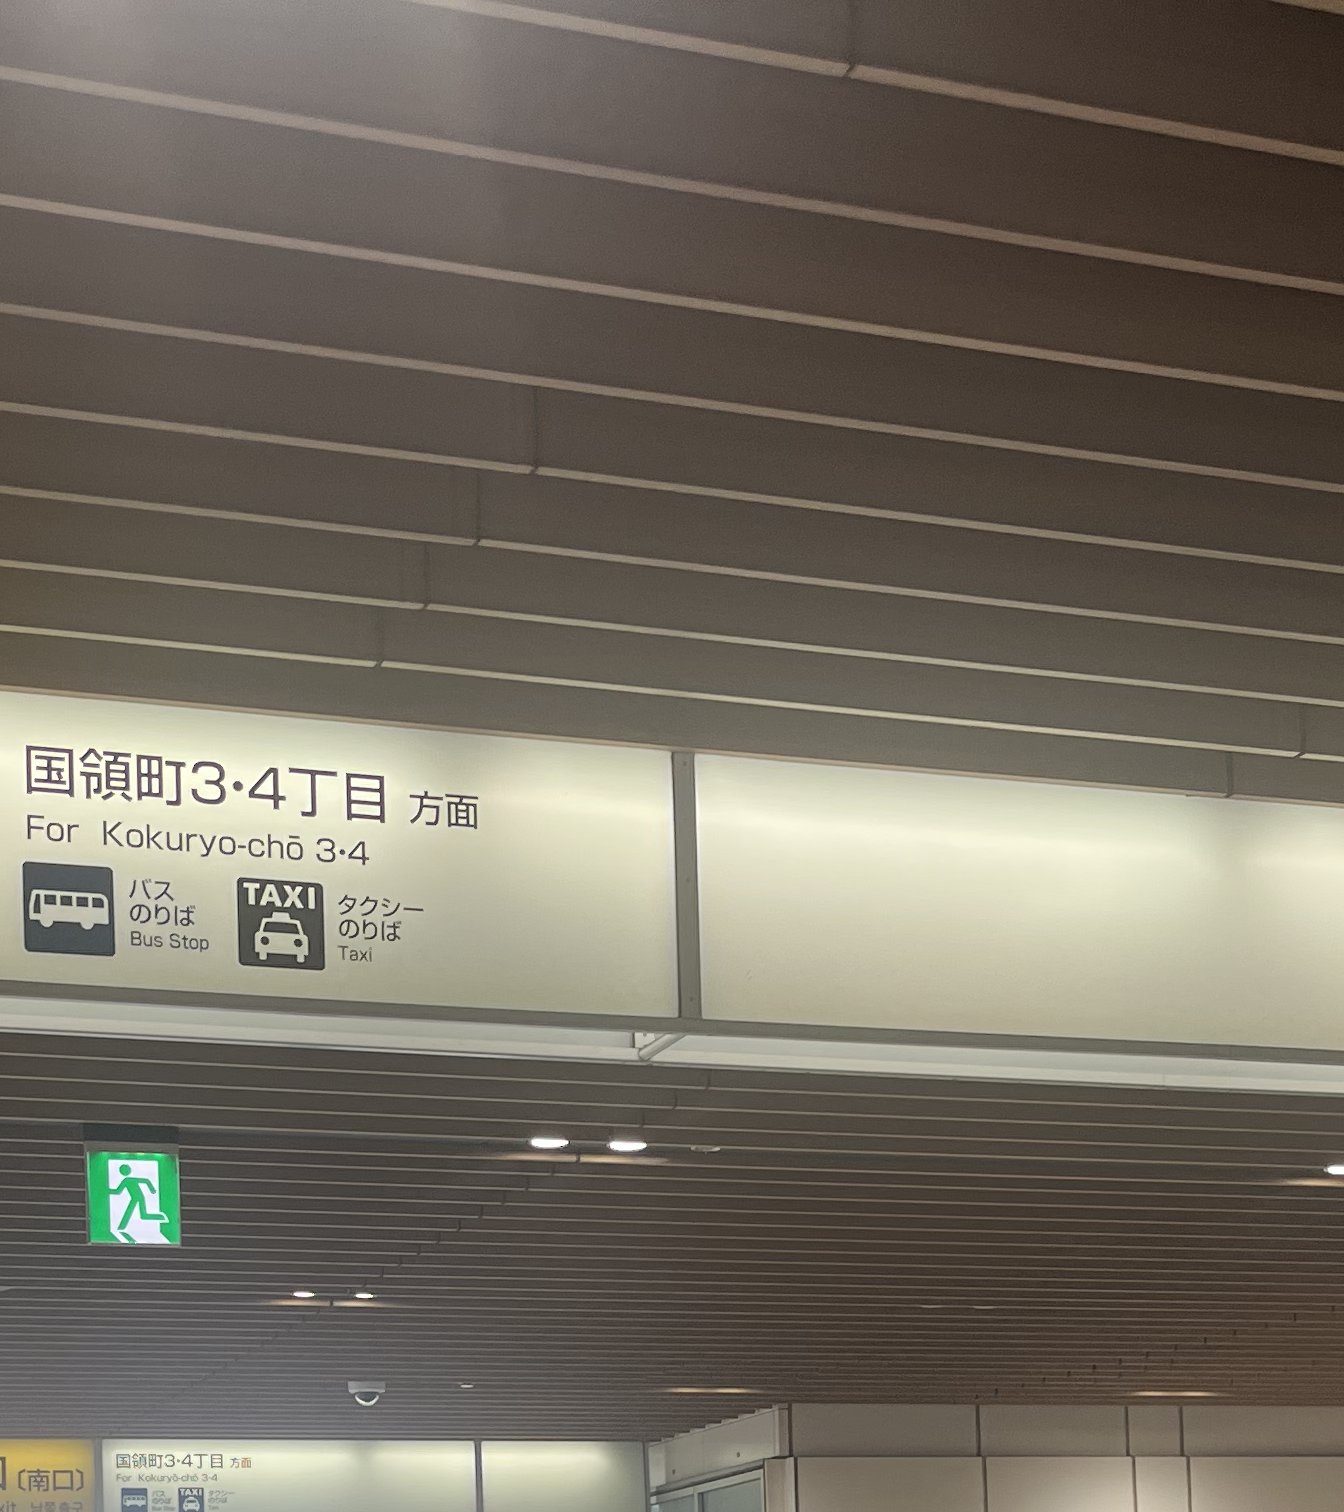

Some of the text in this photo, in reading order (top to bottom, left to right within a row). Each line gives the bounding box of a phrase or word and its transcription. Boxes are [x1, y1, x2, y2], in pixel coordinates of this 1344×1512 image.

[409, 791, 479, 830] 方面
[26, 815, 80, 843] For
[129, 878, 175, 901] バス
[243, 882, 316, 910] TAXI
[129, 903, 196, 927] のりば
[337, 894, 425, 917] タクシー
[130, 931, 210, 953] Bus Stop
[337, 919, 402, 942] のりば
[338, 945, 373, 963] Taxi
[229, 1456, 252, 1469] 方面
[116, 1474, 131, 1482] For
[179, 1488, 202, 1496] TAXI
